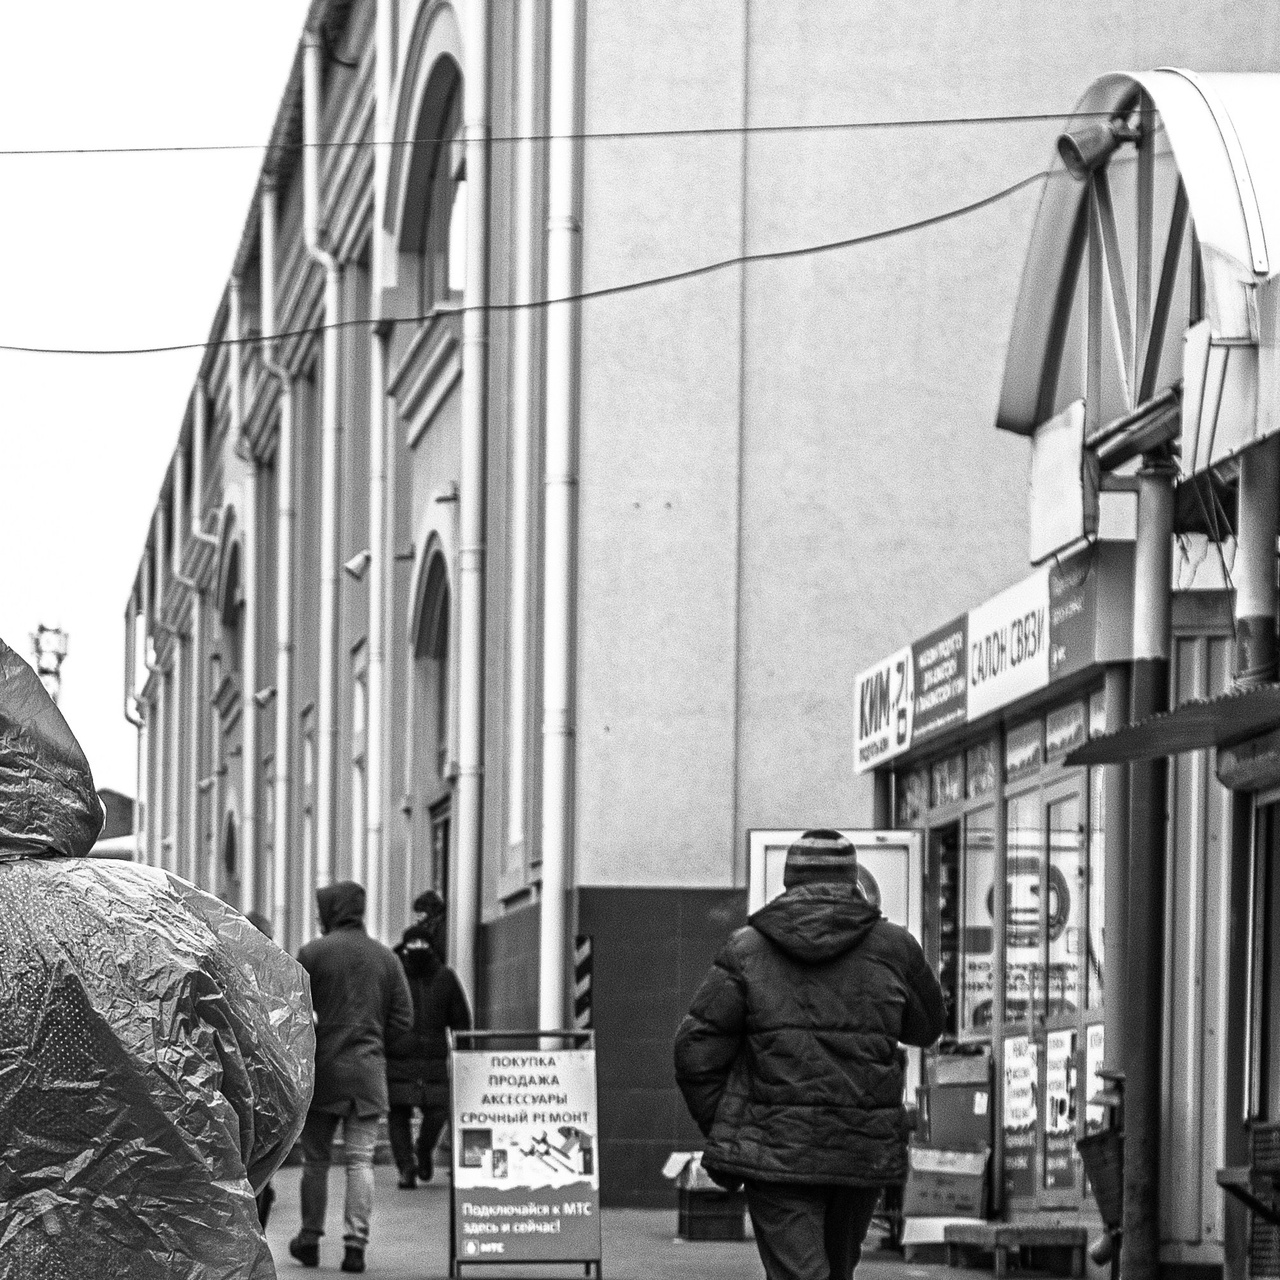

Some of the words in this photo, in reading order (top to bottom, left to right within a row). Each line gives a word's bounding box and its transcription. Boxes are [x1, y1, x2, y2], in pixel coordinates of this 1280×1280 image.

[972, 627, 1007, 686] САЛОН
[1010, 607, 1045, 667] СВЯЗИ
[491, 1056, 556, 1067] ПОКУПКА
[488, 1075, 560, 1087] ПРОДАЖА
[482, 1094, 567, 1105] АКСЕССУАРЫ
[461, 1110, 528, 1123] СРОЧНЫЙ
[533, 1112, 588, 1123] РЕМОНТ
[462, 1202, 550, 1218] Подключайся
[562, 1202, 592, 1216] МТС
